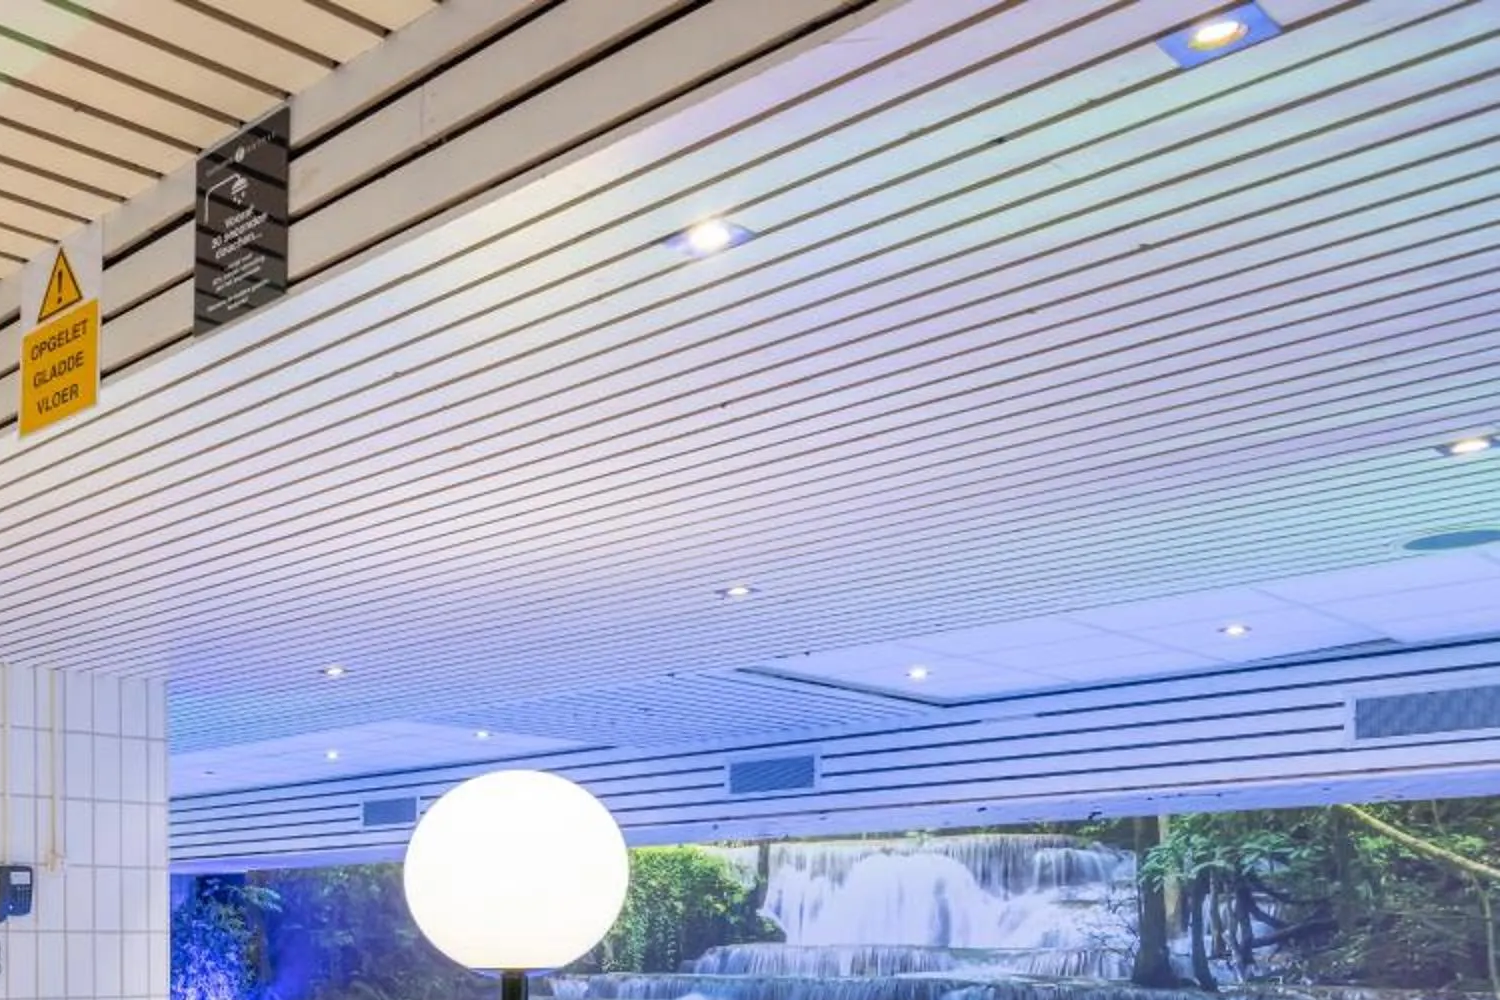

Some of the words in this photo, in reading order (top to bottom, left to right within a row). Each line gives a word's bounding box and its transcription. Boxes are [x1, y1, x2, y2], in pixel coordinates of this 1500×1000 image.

[30, 318, 88, 362] OPGELET
[33, 350, 85, 389] GLADDE
[36, 383, 80, 415] VLOER
